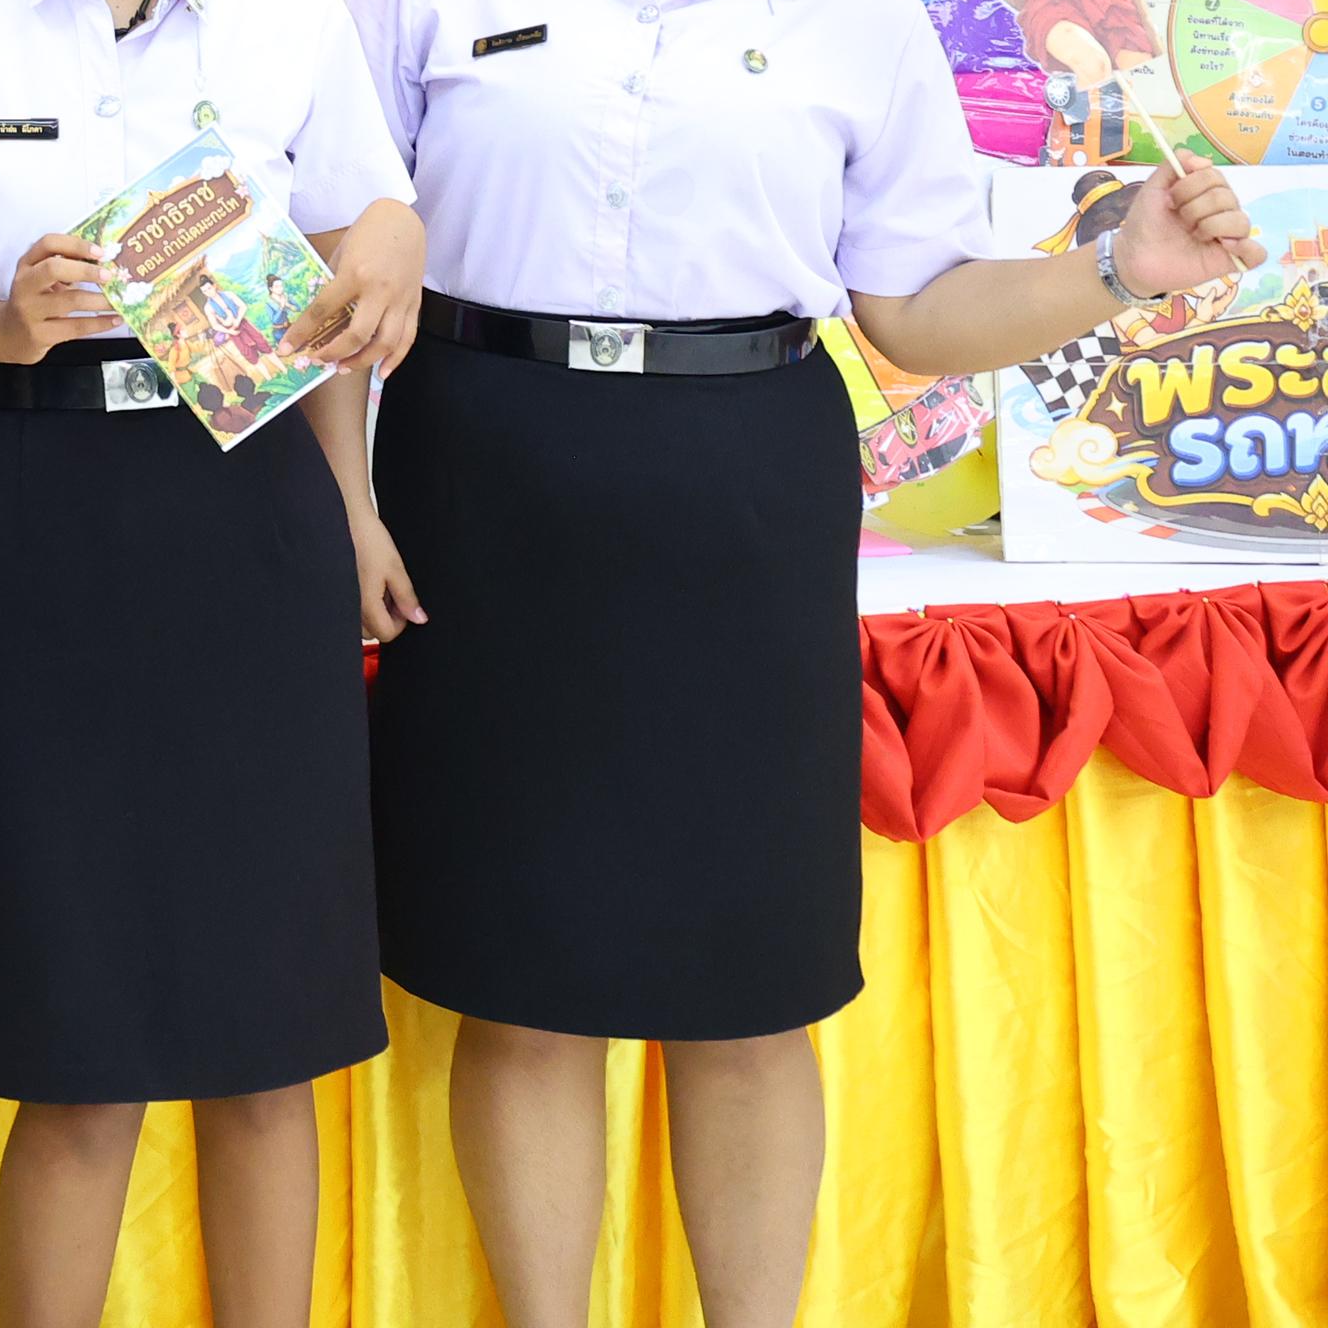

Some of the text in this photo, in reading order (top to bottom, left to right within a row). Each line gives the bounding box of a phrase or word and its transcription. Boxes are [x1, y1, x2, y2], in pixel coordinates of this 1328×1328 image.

[1314, 99, 1324, 111] 5
[127, 182, 216, 254] ราชาธิราช
[135, 196, 241, 279] ตอน กำเนิดมะกะโท
[1127, 340, 1328, 427] พระ
[1169, 412, 1328, 488] รถห
